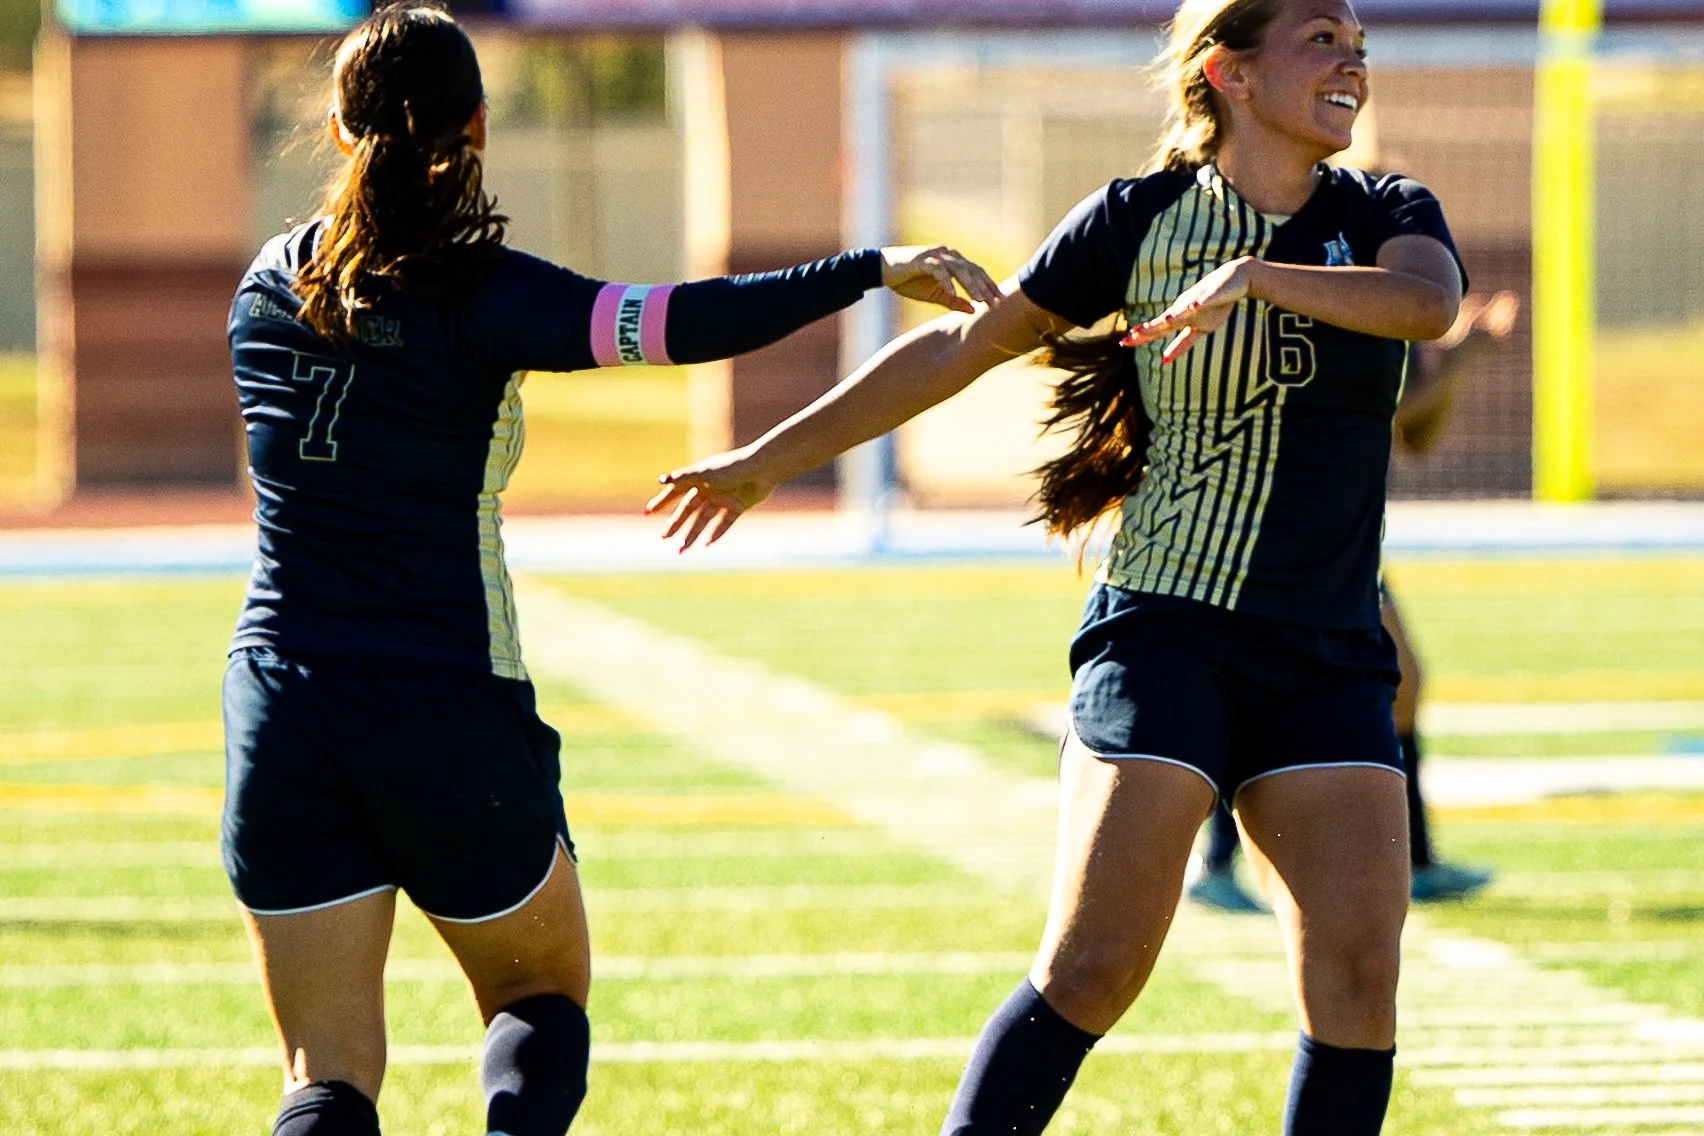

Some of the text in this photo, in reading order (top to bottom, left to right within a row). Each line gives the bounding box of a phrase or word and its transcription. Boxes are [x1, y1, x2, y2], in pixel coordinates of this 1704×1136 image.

[619, 299, 643, 362] CAPTAIN
[1266, 304, 1316, 387] 6
[291, 350, 356, 462] 7
